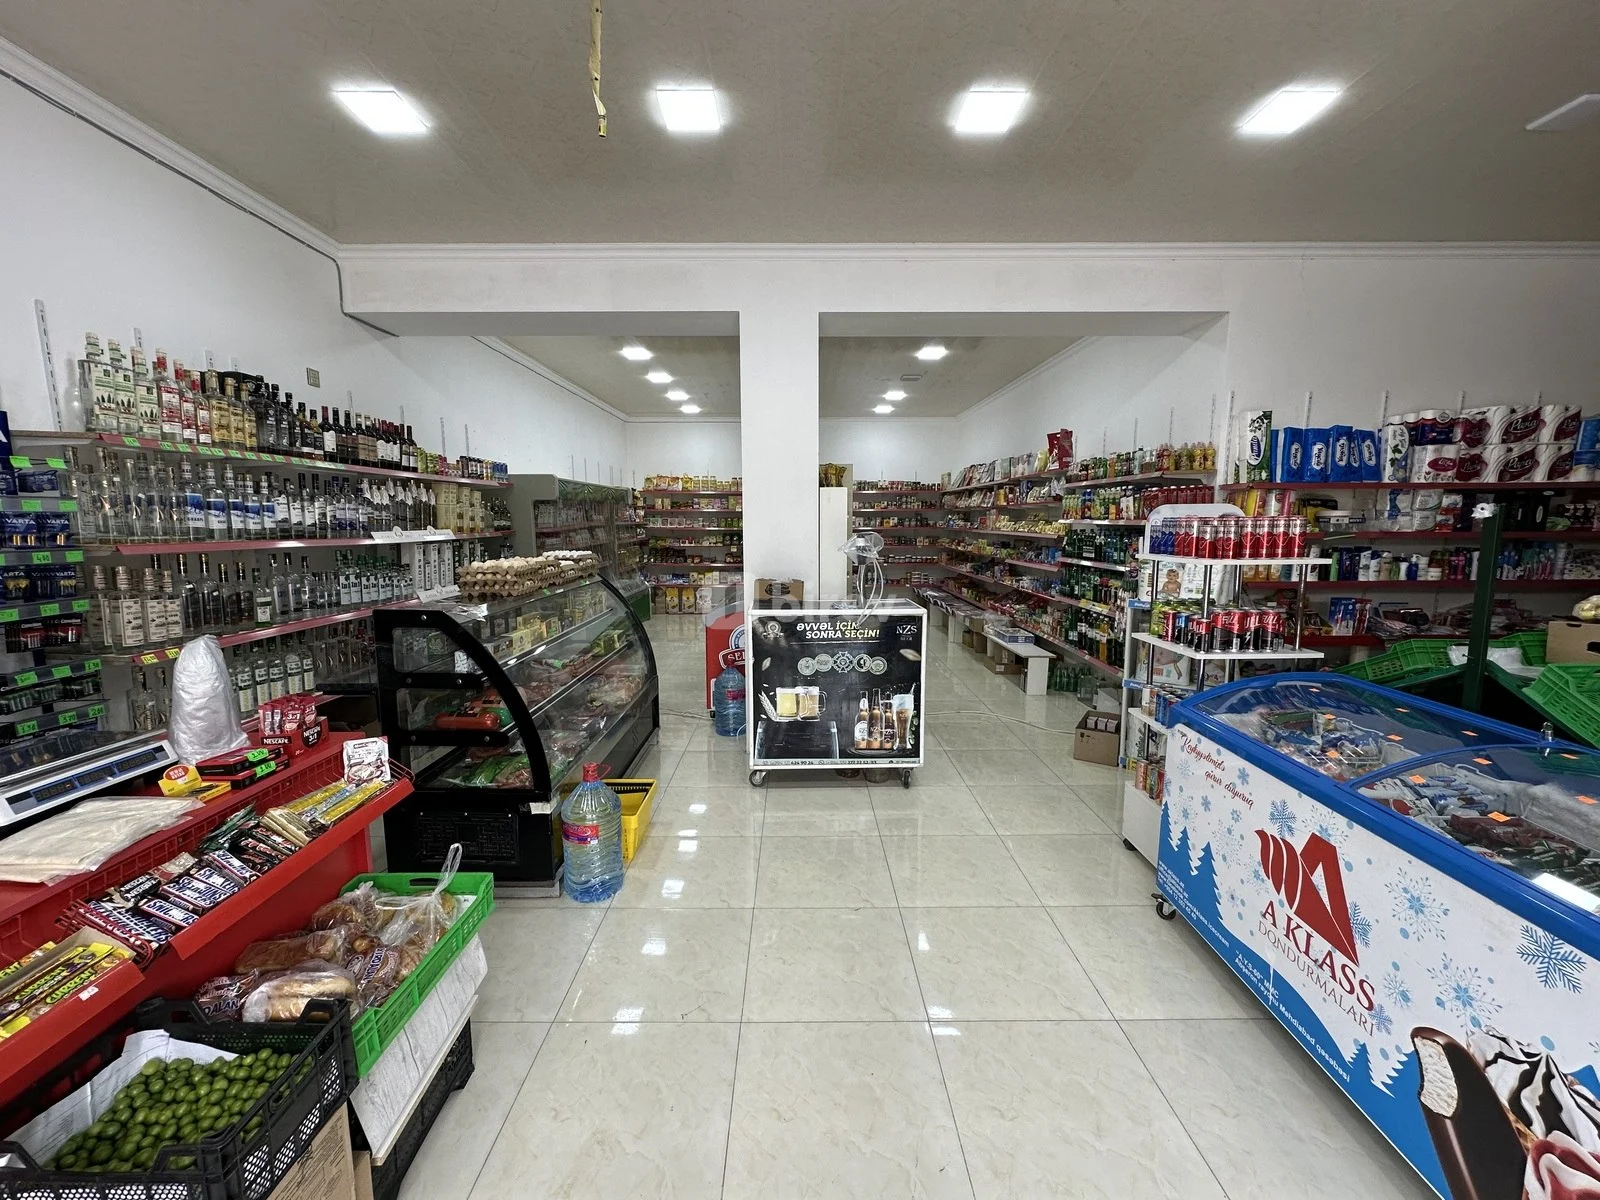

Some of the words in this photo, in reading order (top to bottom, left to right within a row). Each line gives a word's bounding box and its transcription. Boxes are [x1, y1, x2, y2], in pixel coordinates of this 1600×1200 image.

[805, 630, 842, 639] SONRA
[844, 628, 880, 640] SEÇİN!
[896, 624, 918, 635] NZS
[1262, 900, 1278, 929] A
[1283, 913, 1376, 1012] KLASS
[45, 967, 97, 1004] CURRENT
[1258, 920, 1376, 1037] DONDURMALARI
[1280, 1003, 1315, 1046] Mehdiabad
